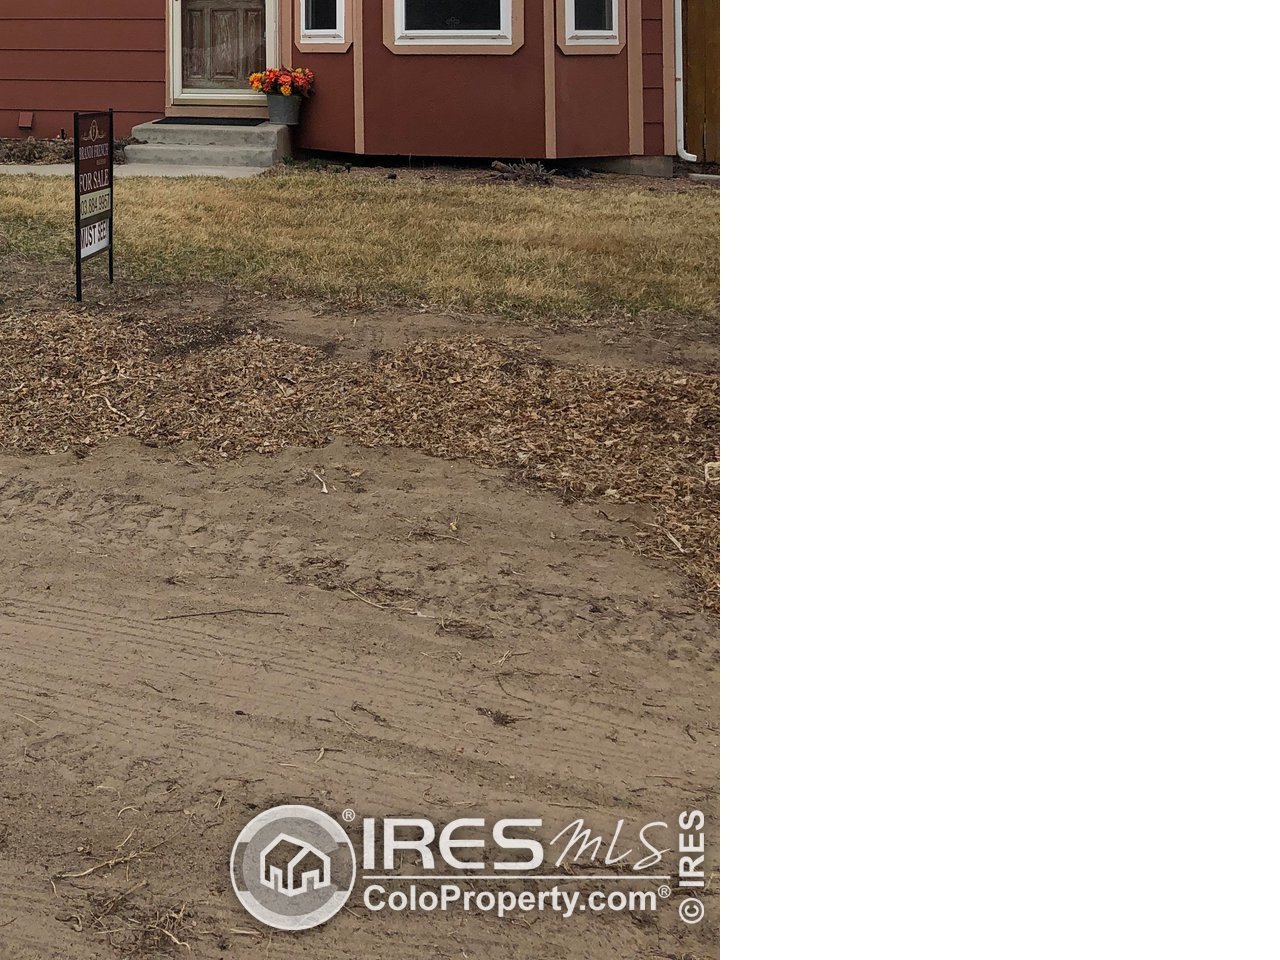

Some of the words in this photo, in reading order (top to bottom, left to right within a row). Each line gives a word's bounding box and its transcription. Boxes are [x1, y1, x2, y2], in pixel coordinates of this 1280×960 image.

[79, 173, 92, 192] FOR
[93, 169, 109, 189] SALE
[80, 224, 96, 249] MUST
